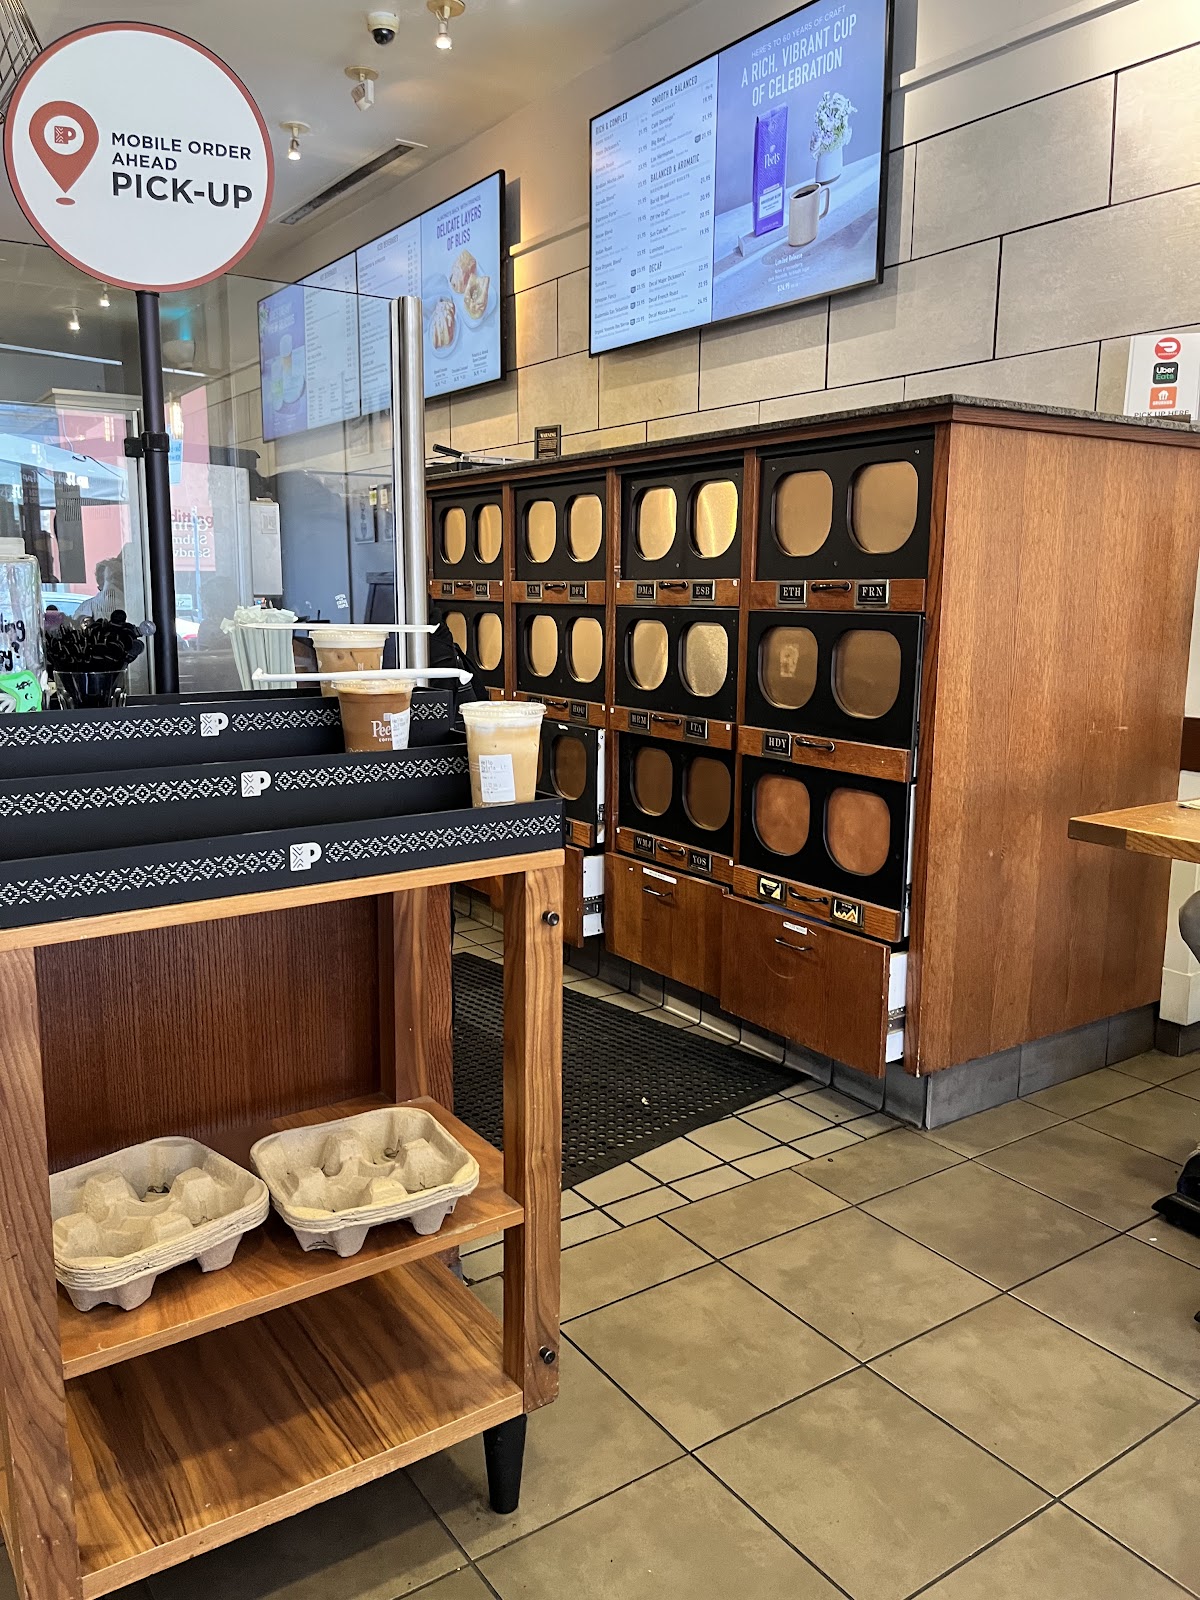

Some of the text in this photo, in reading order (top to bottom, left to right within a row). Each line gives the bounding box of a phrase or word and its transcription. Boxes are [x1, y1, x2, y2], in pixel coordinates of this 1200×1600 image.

[751, 5, 846, 58] HERE'S TO 60 YEARS OF CRAFT
[741, 67, 748, 88] A
[782, 26, 830, 67] VIBRANT
[834, 14, 856, 43] CUP
[752, 46, 842, 107] OF CELEBRATION
[651, 91, 670, 106] SMOOTH
[675, 75, 698, 94] BALANCED
[112, 132, 251, 160] MOBILE ORDER
[112, 152, 177, 170] AHEAD
[650, 165, 672, 183] BALANCED
[678, 153, 700, 170] AROMATIC
[113, 171, 252, 209] PICK-UP
[437, 204, 481, 239] DELICATE LAYERS
[447, 228, 470, 251] OF BLISS
[649, 260, 661, 273] DECAF
[637, 586, 652, 595] DMA
[695, 586, 710, 595] ESB
[783, 586, 801, 597] ETH
[862, 586, 883, 597] FRN
[572, 704, 585, 714] HOU
[690, 722, 702, 733] ITA
[769, 737, 787, 748] HDY
[692, 854, 707, 866] YOS
